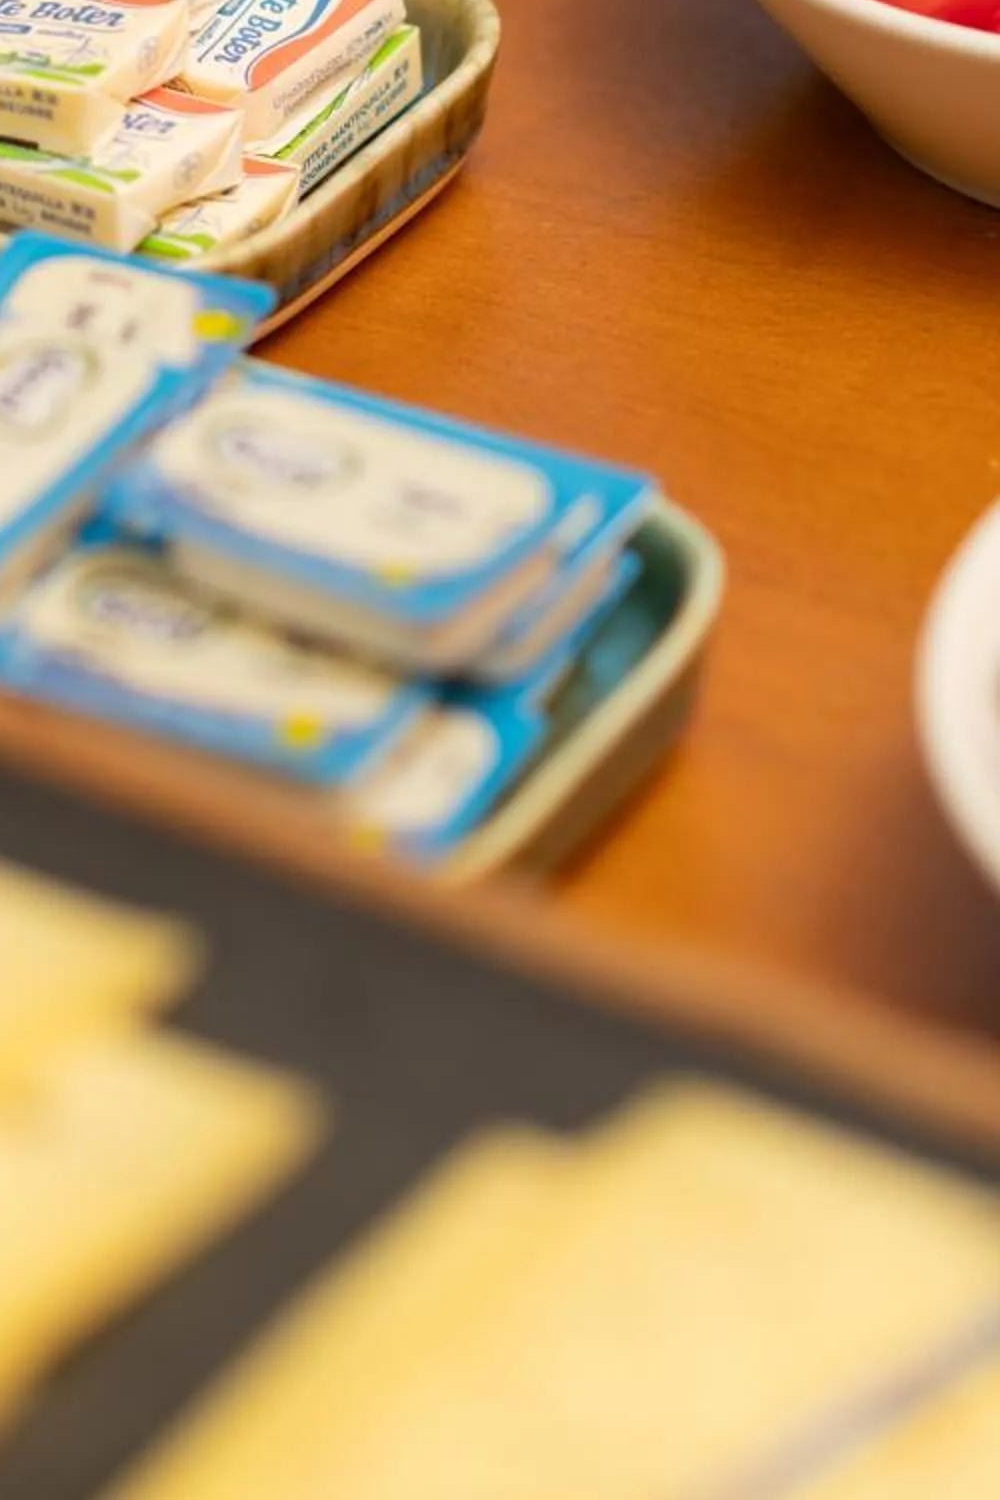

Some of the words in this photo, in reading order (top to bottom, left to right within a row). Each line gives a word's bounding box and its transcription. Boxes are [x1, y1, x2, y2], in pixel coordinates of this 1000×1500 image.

[30, 0, 126, 29] Boter
[213, 14, 283, 64] Boter
[121, 111, 179, 135] ter
